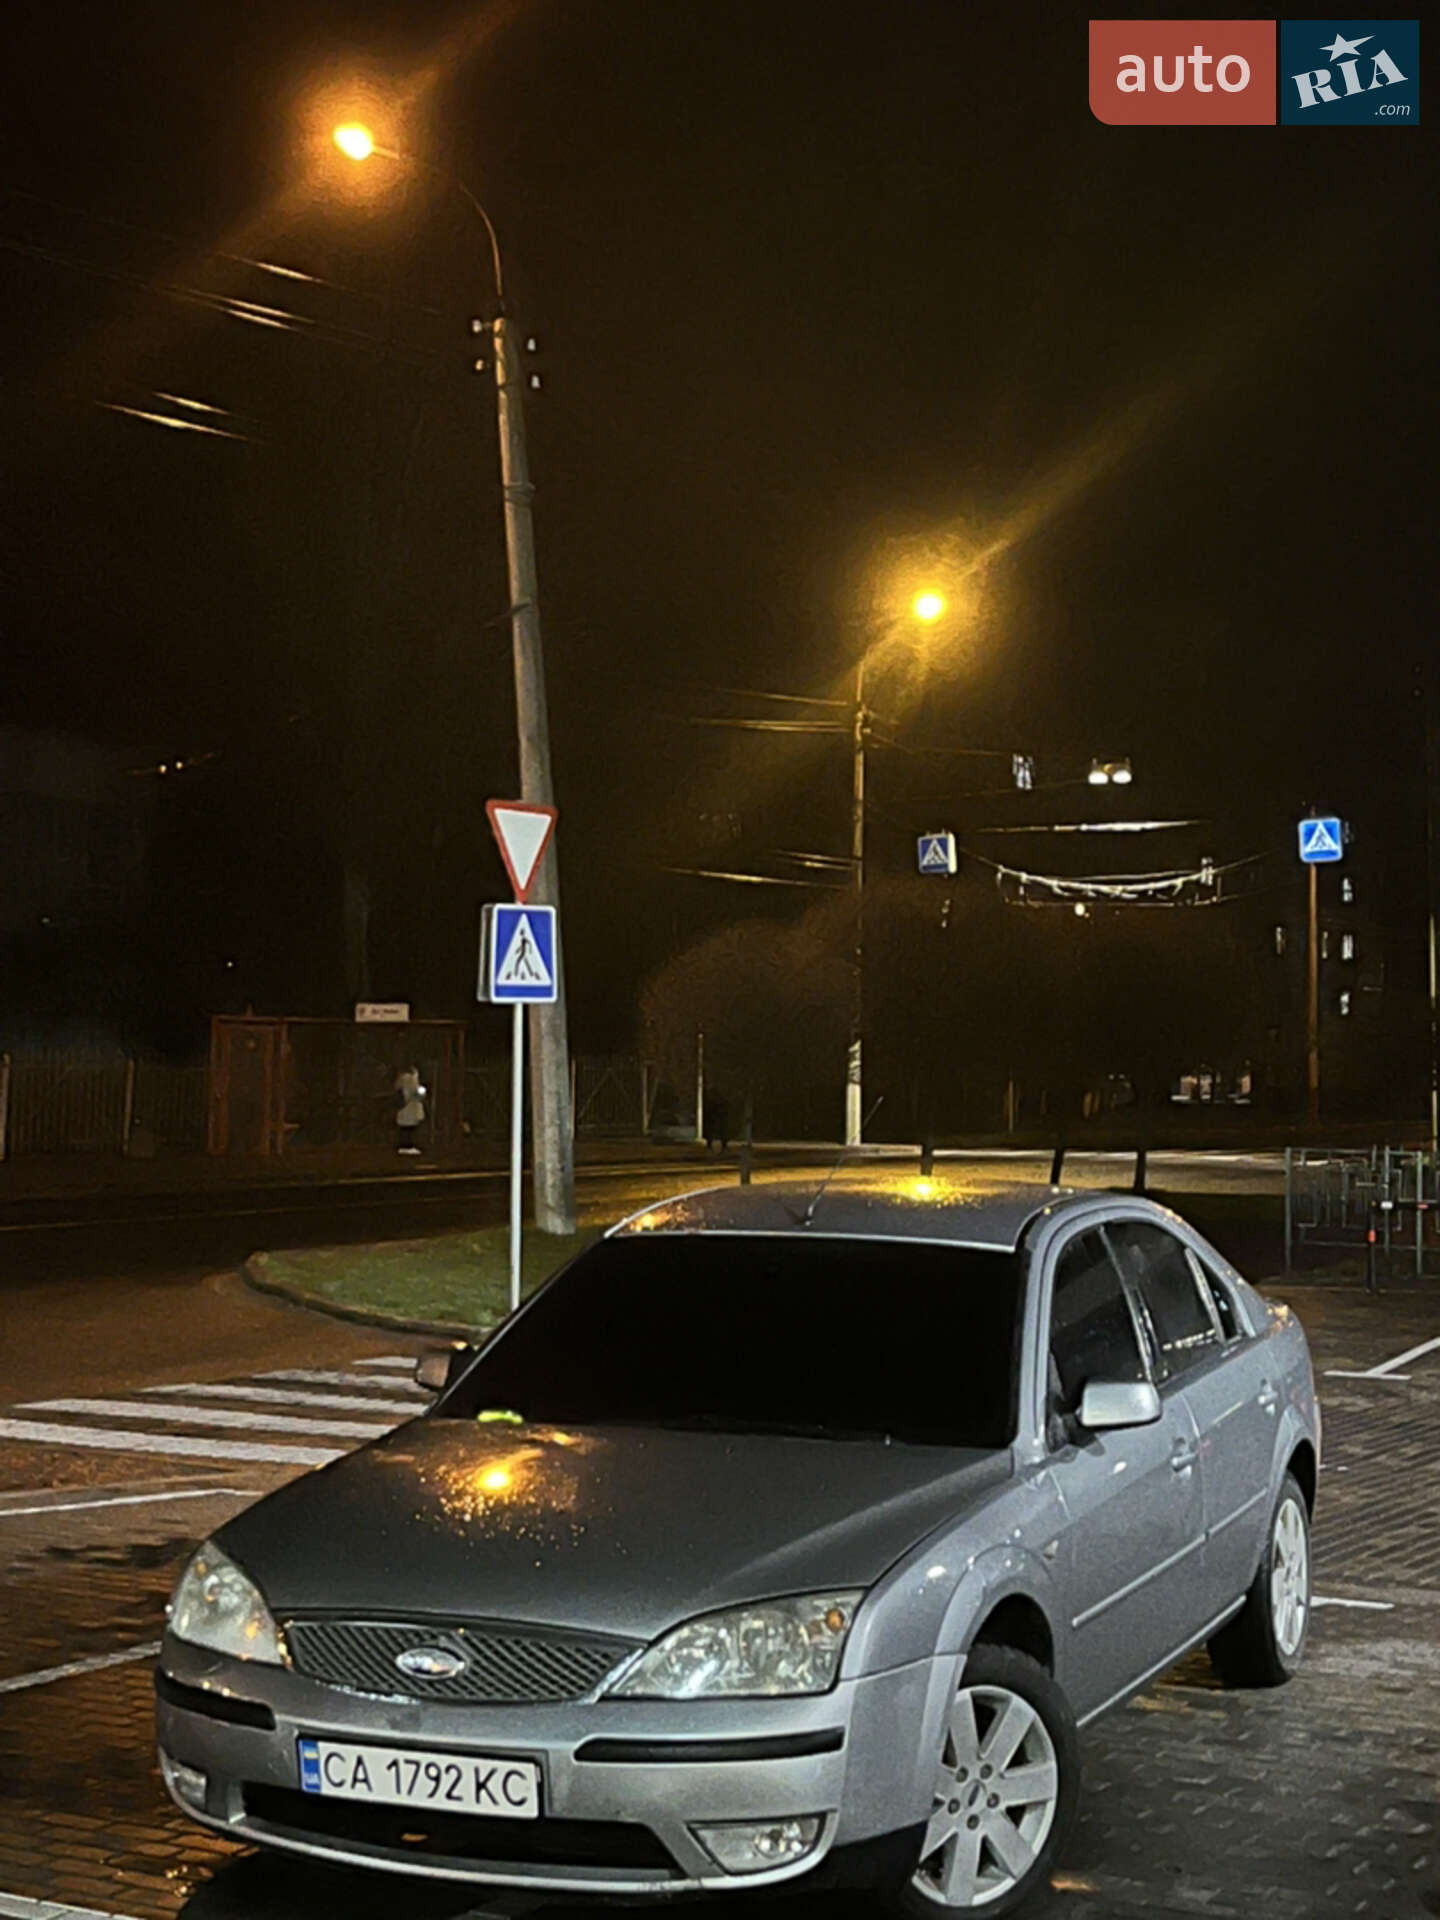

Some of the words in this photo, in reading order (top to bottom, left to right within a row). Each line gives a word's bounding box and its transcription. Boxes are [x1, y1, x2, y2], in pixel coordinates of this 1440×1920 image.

[323, 1752, 373, 1793] CA
[386, 1758, 463, 1801] 1792
[474, 1766, 528, 1807] KC
